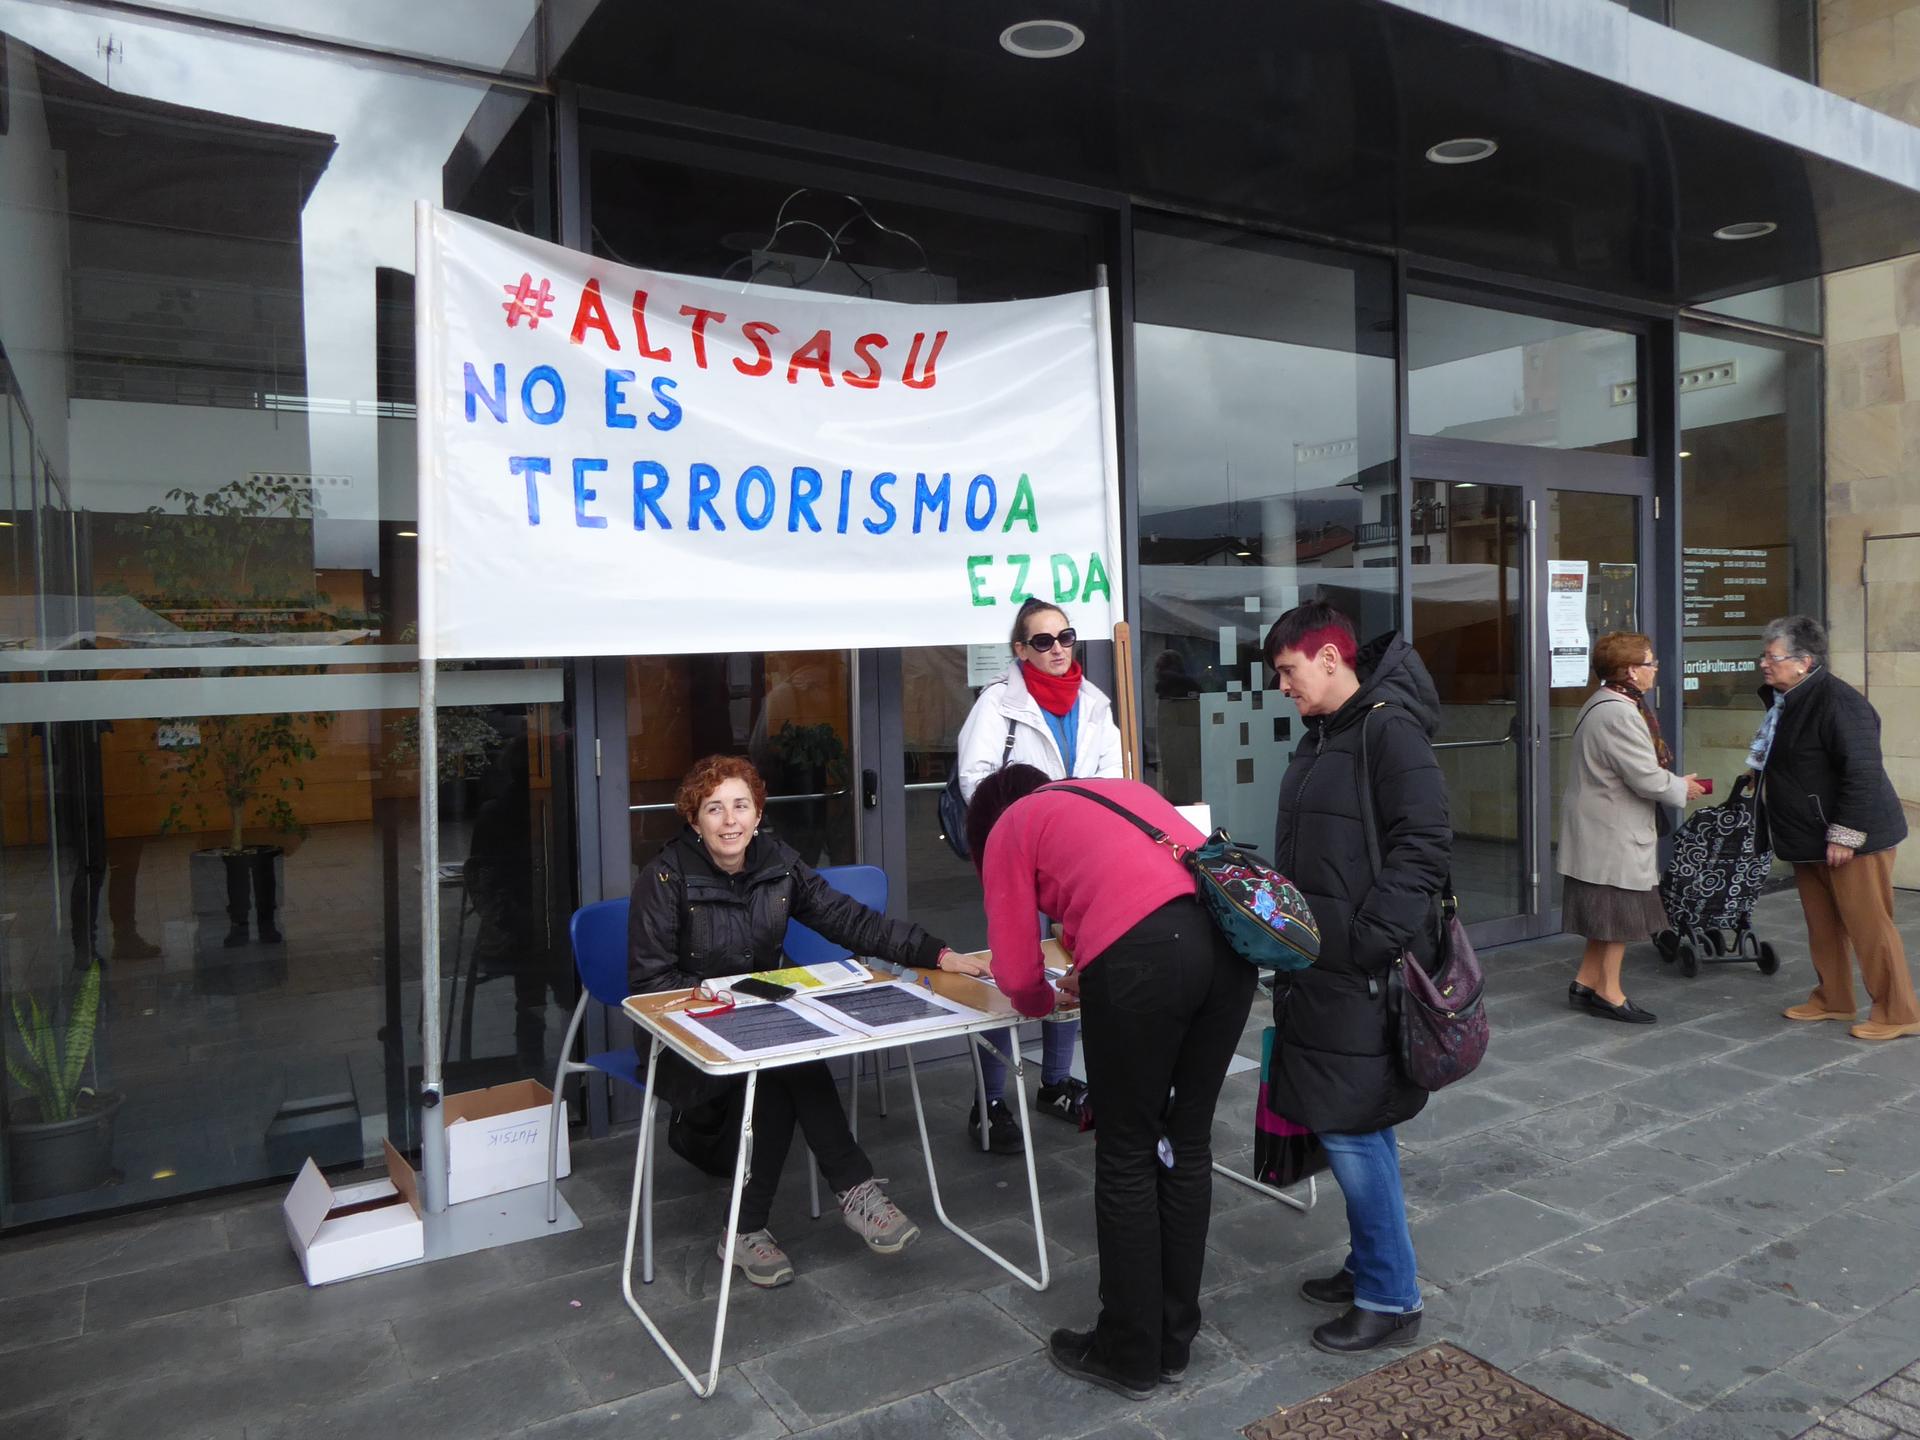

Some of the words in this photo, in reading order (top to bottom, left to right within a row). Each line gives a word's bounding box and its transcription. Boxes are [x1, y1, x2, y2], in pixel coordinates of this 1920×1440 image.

[502, 273, 947, 389] #ALTSASU
[464, 362, 566, 425] NO
[604, 369, 683, 431] ES
[510, 457, 1038, 533] TERRORISMOA
[967, 555, 1033, 605] EZ
[1051, 553, 1110, 603] DA
